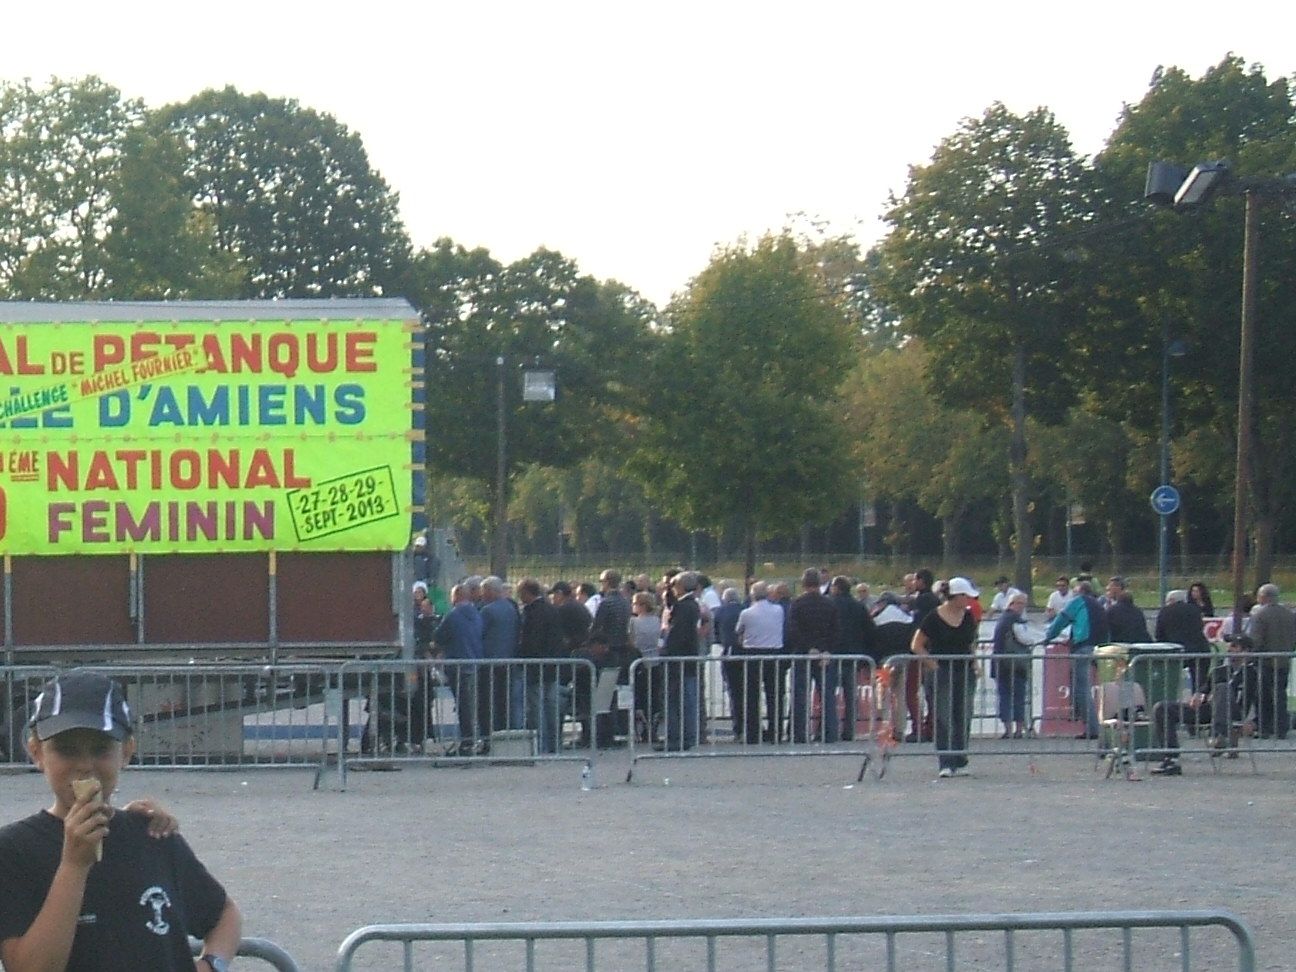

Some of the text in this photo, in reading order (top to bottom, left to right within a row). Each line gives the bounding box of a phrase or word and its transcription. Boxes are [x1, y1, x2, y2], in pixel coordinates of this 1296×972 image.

[51, 351, 85, 376] DE
[98, 383, 367, 428] D'AMIENS
[46, 448, 312, 492] NATIONAL
[47, 500, 275, 544] FEMININ
